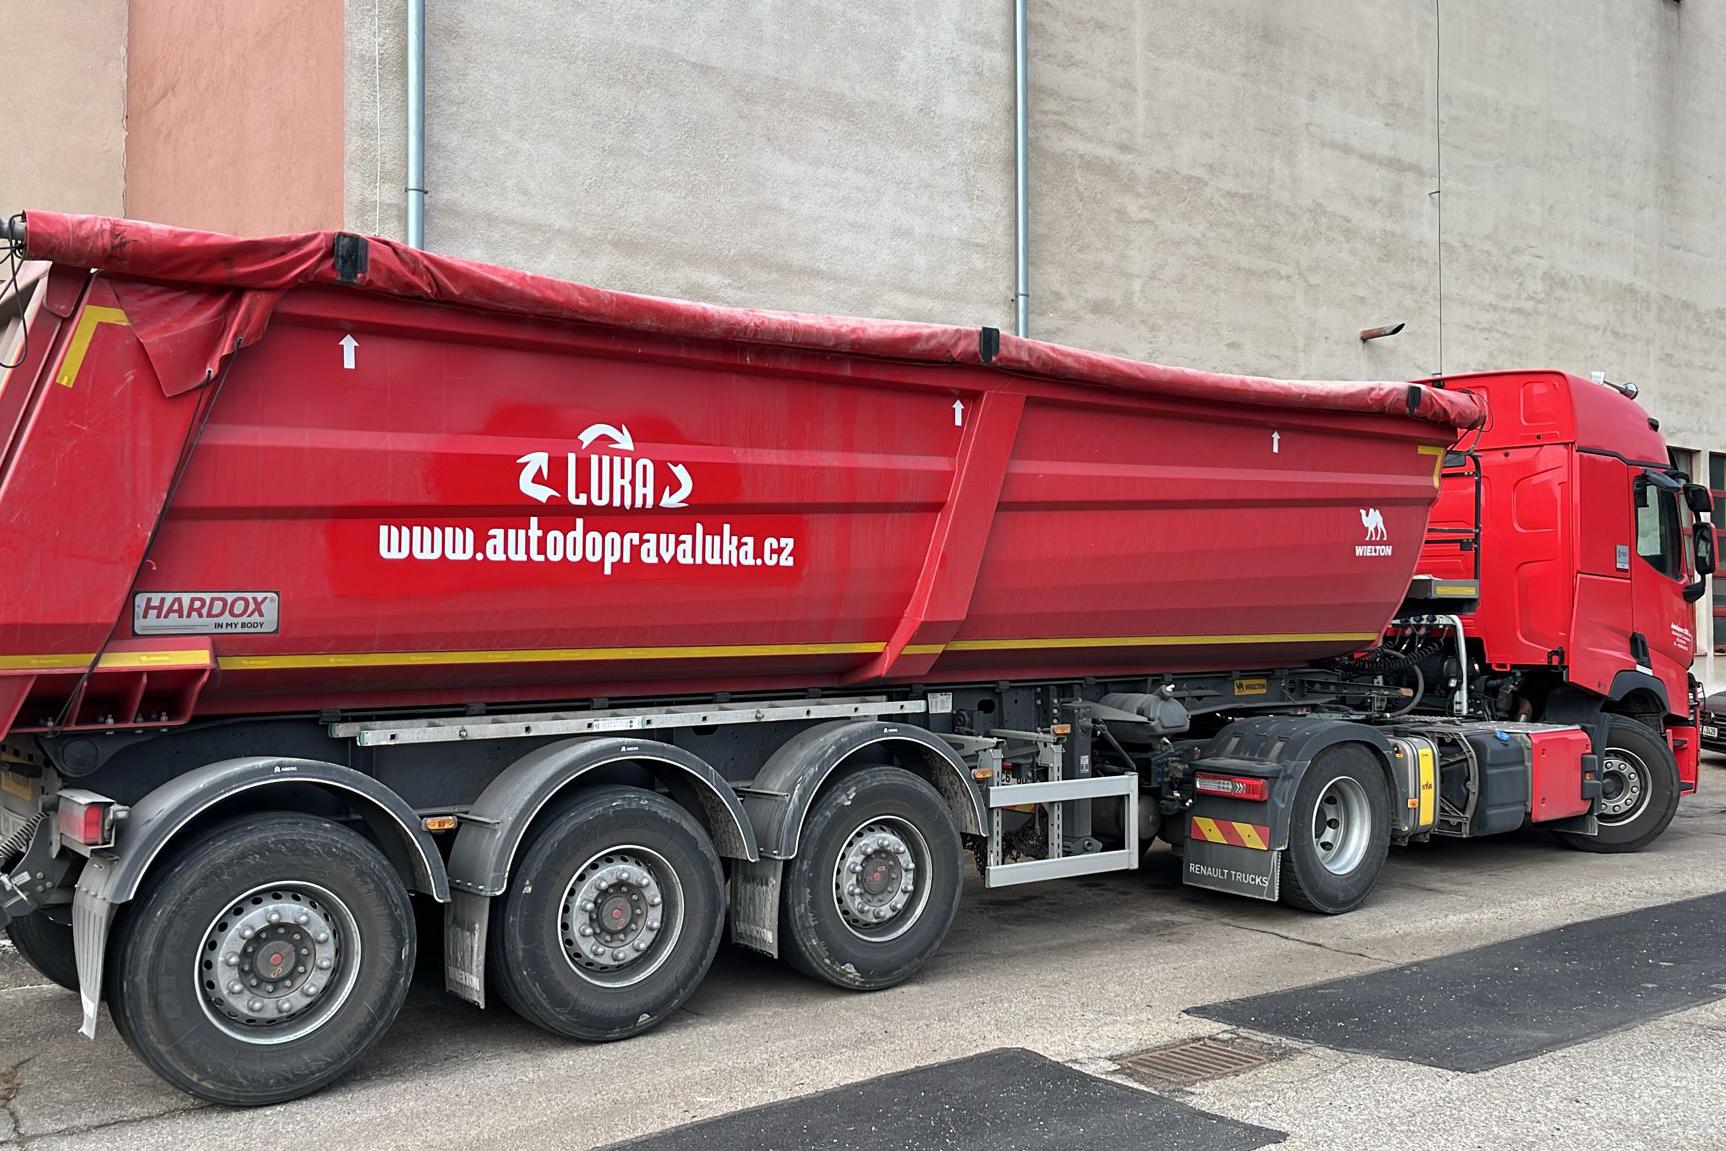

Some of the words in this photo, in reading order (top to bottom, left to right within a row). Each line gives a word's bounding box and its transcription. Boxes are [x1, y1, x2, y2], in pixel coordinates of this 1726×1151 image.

[567, 452, 655, 510] LUKA
[379, 516, 794, 575] www.autodopravaluka.cz
[1355, 545, 1392, 557] WIELTON
[241, 621, 265, 629] BODY
[1189, 862, 1229, 880] RENAULT
[1230, 870, 1269, 887] TRUCKS
